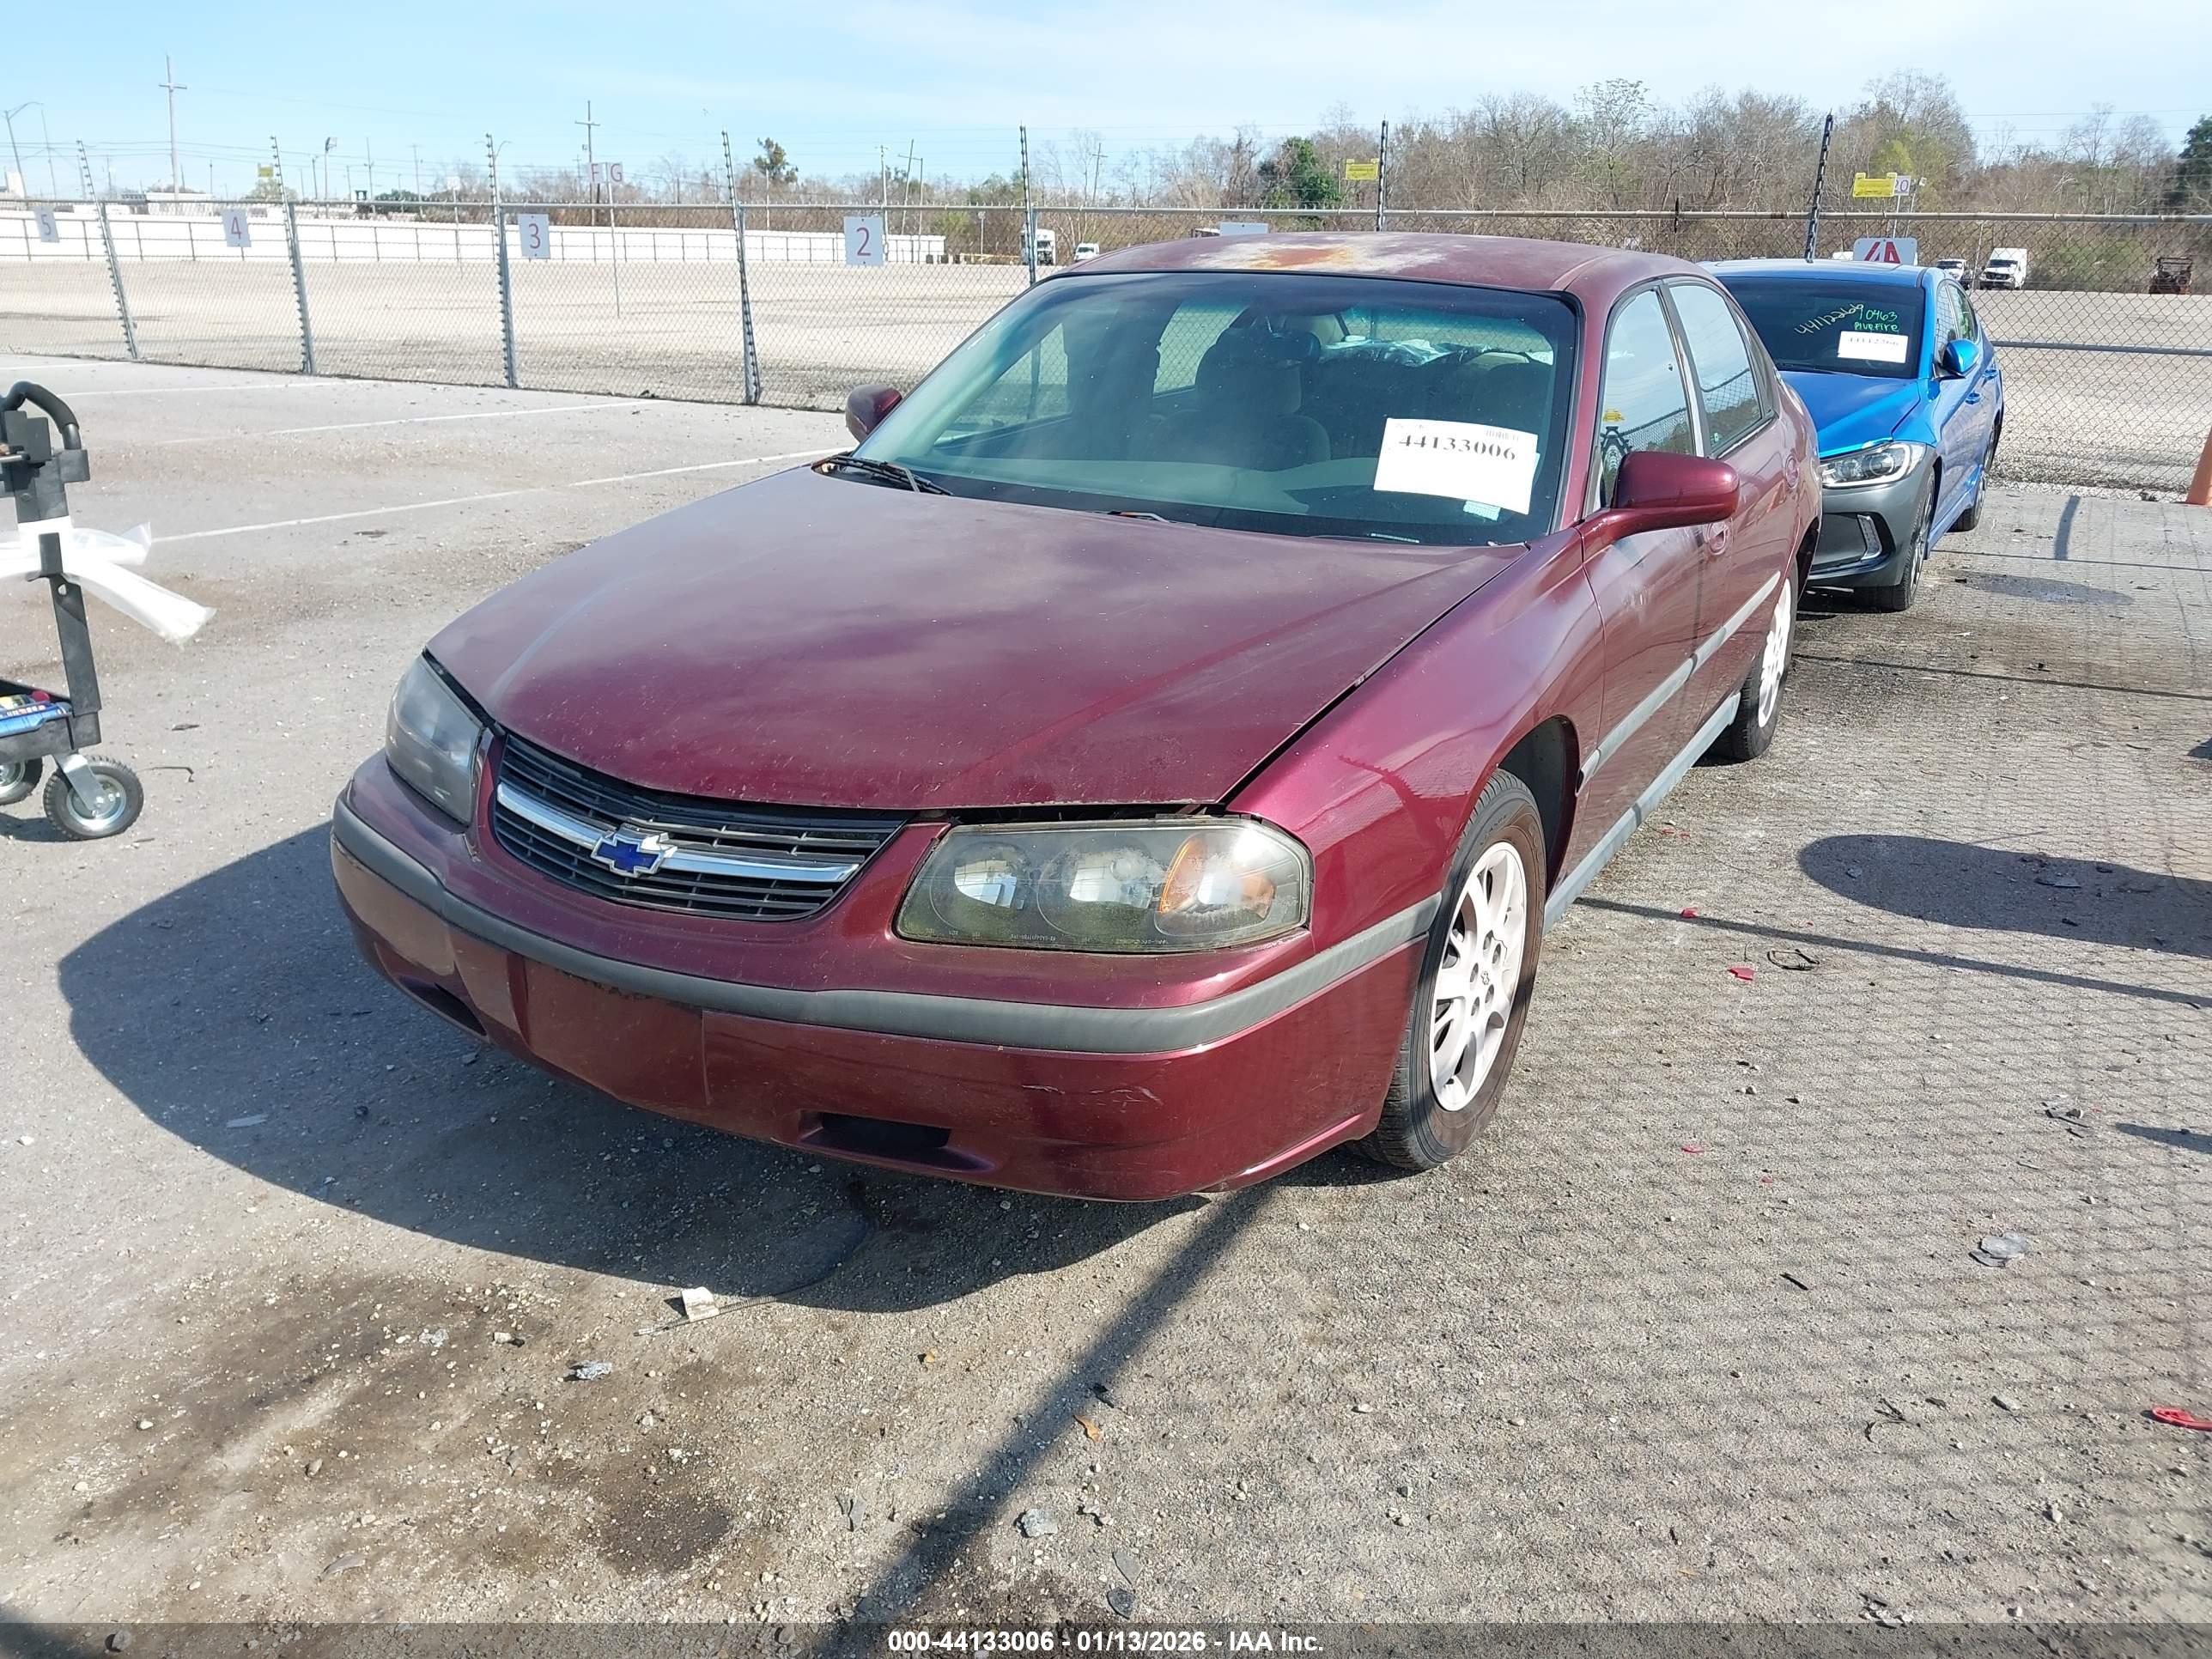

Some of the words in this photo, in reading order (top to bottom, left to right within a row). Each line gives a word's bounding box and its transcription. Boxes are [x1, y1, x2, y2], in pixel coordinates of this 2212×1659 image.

[591, 163, 599, 182] F
[611, 163, 623, 182] G
[42, 214, 52, 235] 5
[230, 217, 241, 240] 4
[528, 222, 541, 249] 3
[856, 227, 872, 257] 2
[1398, 434, 1516, 460] 44133006
